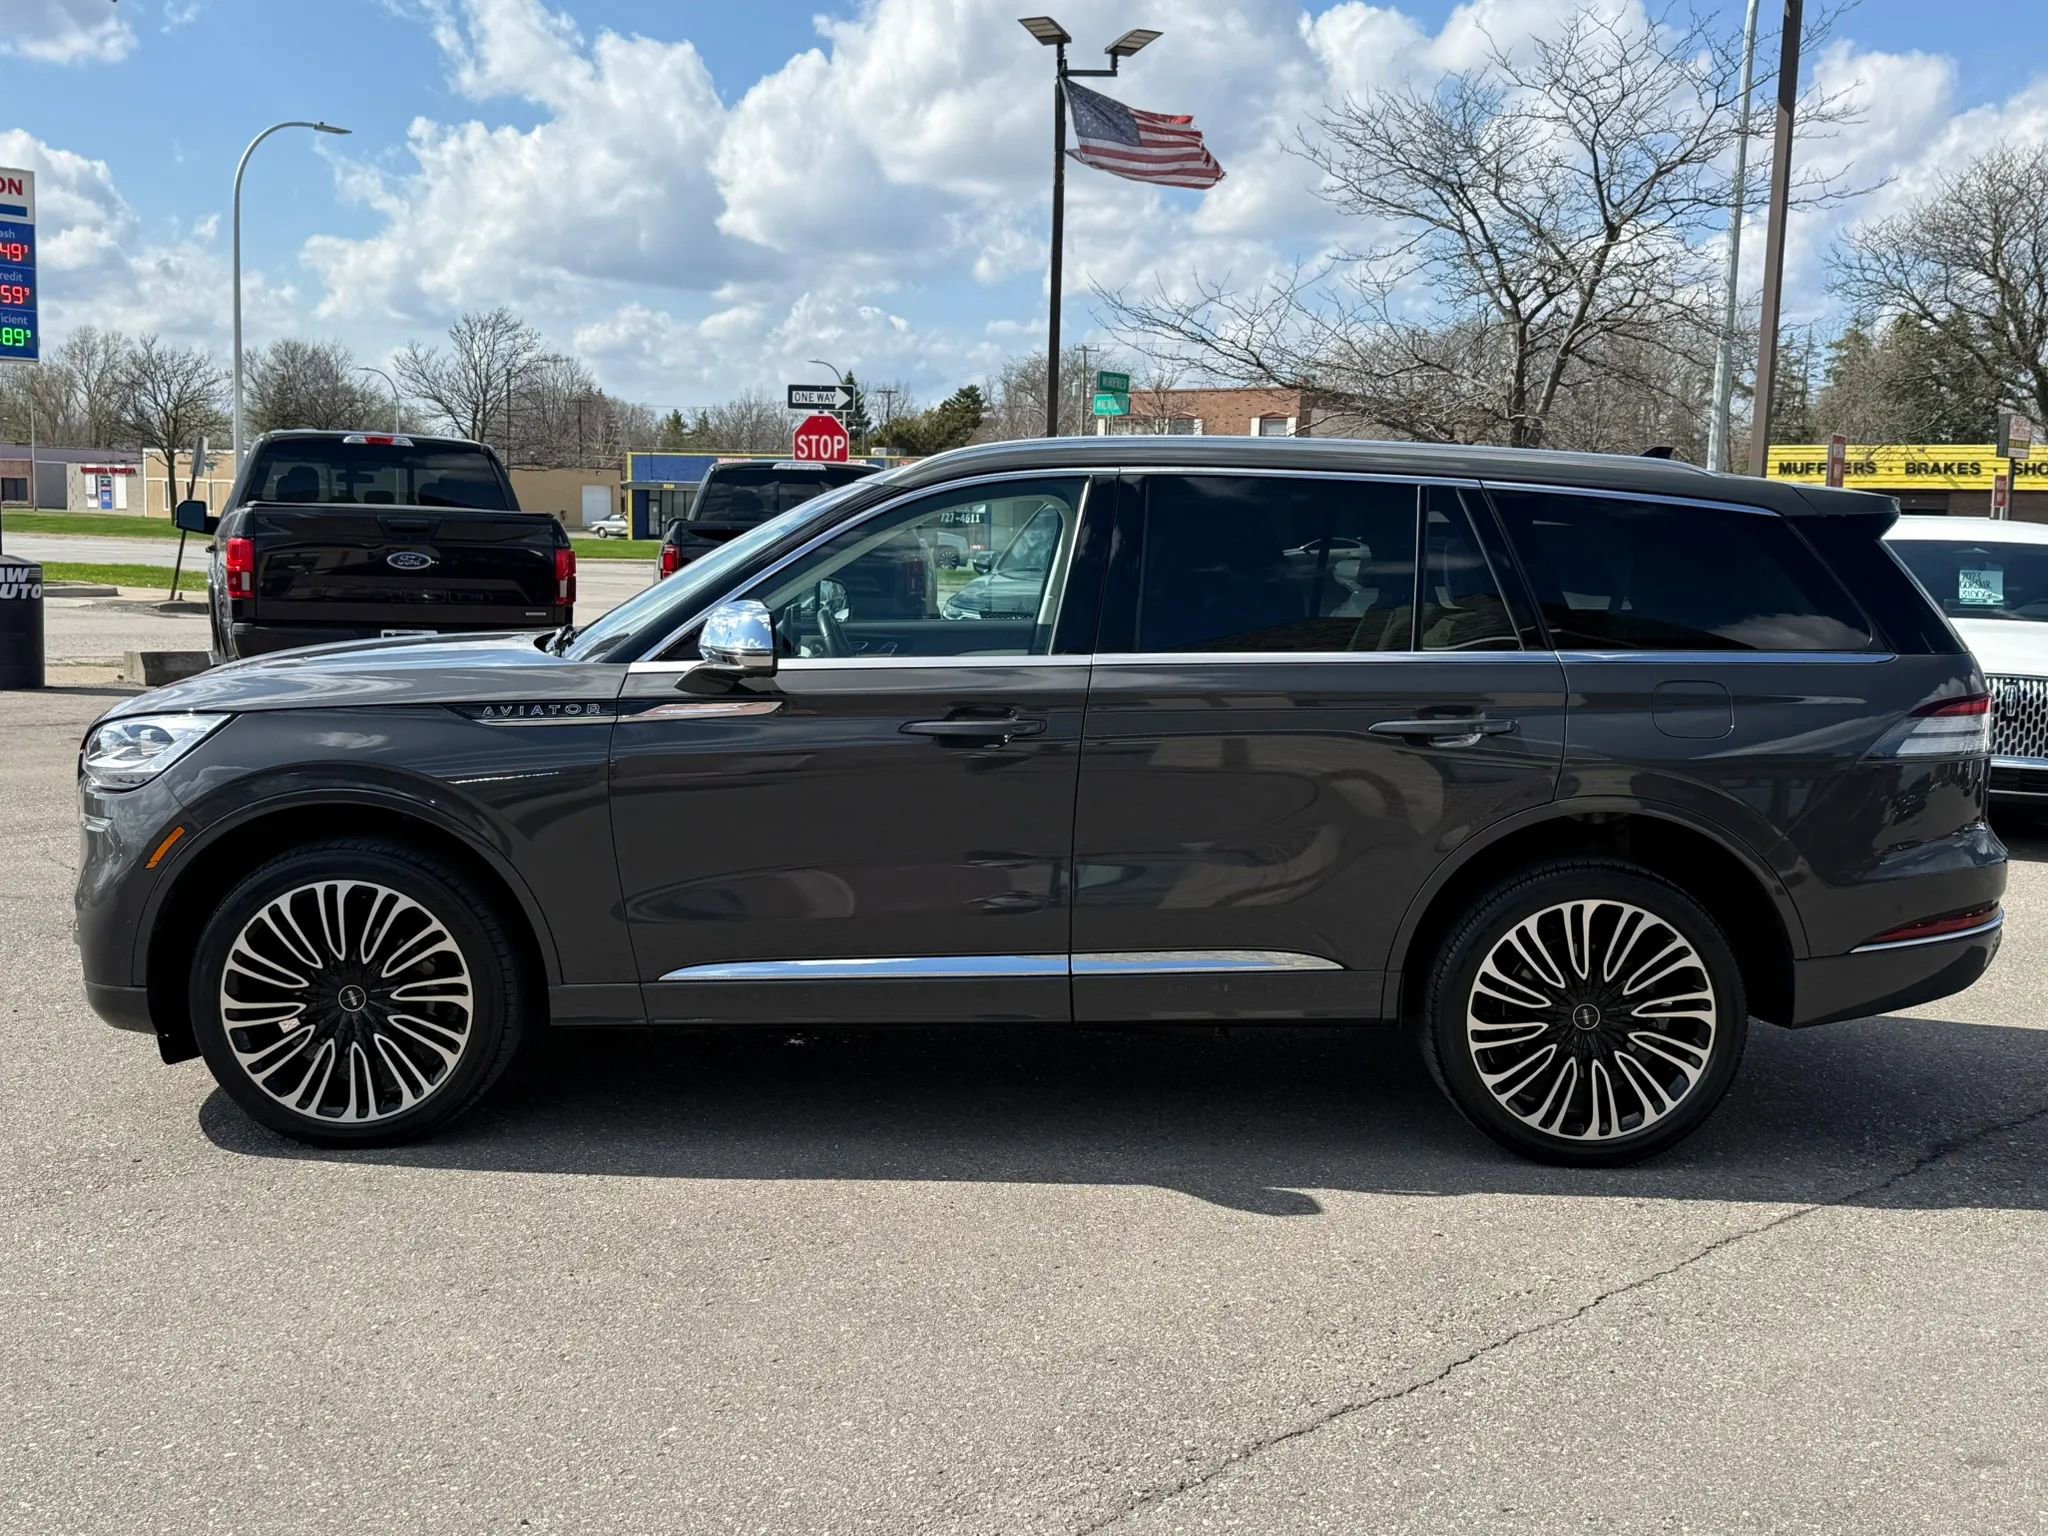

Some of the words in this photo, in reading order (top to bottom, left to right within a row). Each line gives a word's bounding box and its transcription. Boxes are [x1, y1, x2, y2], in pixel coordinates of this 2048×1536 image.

[794, 392, 814, 403] ONE
[817, 393, 836, 403] WAY
[797, 435, 845, 459] STOP
[1779, 462, 1877, 475] MUFFERS
[1905, 462, 1982, 475] BRAKES
[2014, 462, 2048, 476] SHO
[940, 512, 980, 523] 727-4611
[482, 704, 600, 717] AVIATOR
